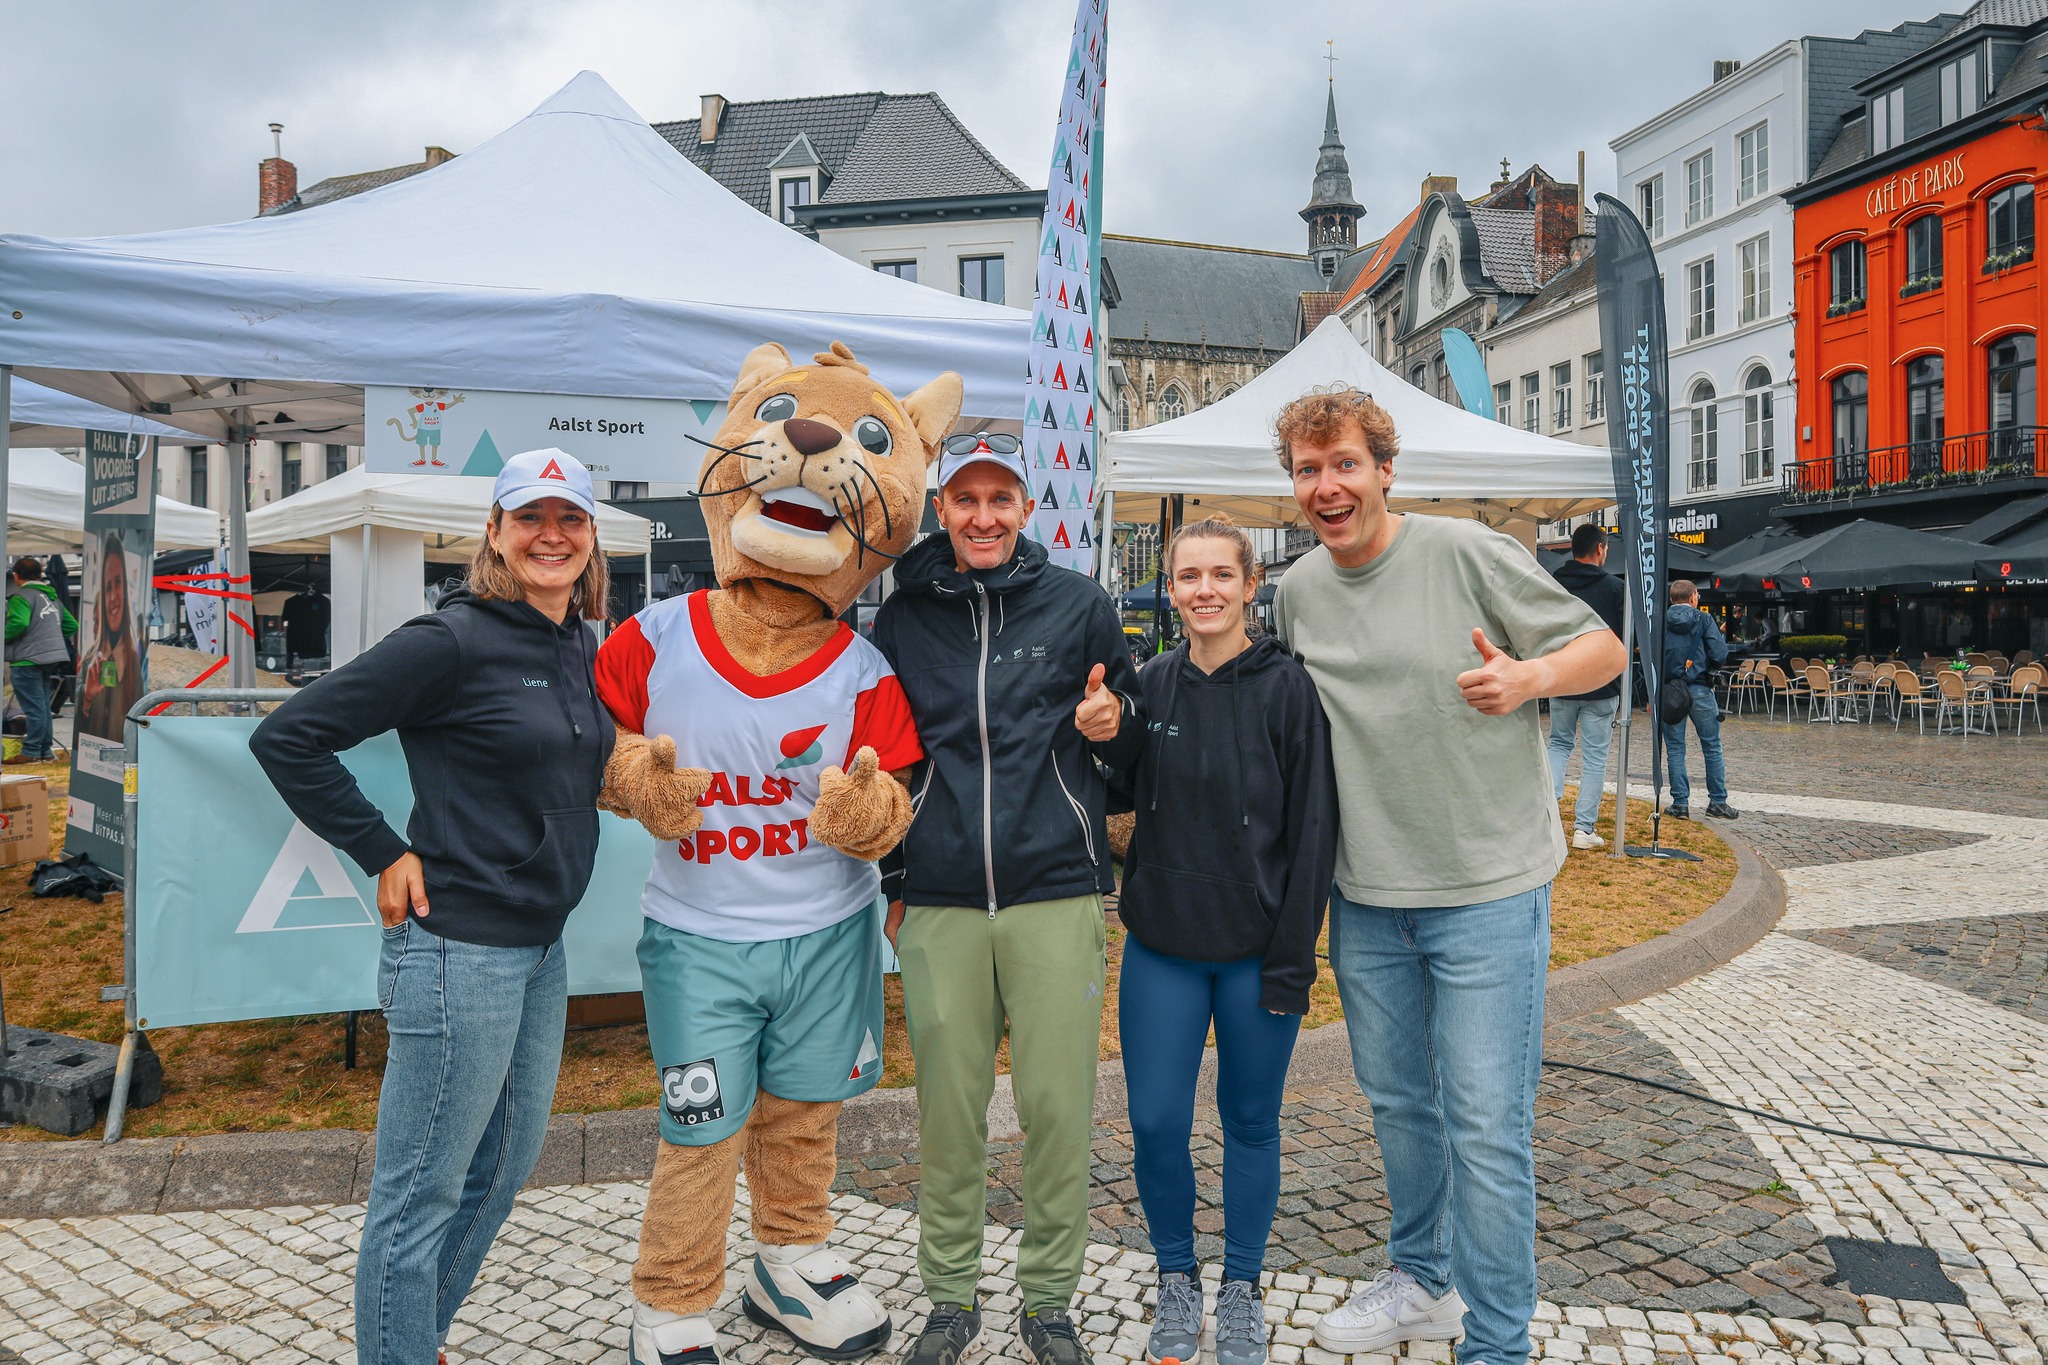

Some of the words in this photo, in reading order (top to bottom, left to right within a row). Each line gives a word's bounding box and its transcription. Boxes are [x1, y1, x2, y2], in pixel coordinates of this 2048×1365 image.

[1866, 175, 1897, 218] CAFÉ
[1902, 172, 1919, 206] DE
[1925, 153, 1964, 197] PARIS
[548, 417, 593, 432] Aalst
[597, 419, 645, 436] Sport
[93, 431, 118, 453] HAAL
[120, 437, 137, 455] MER
[93, 457, 136, 481] VOORDEEL
[522, 677, 549, 688] Liene
[96, 806, 112, 822] Meer
[112, 811, 125, 827] inf
[95, 823, 125, 845] UiTPAS.b
[663, 1066, 718, 1108] GO
